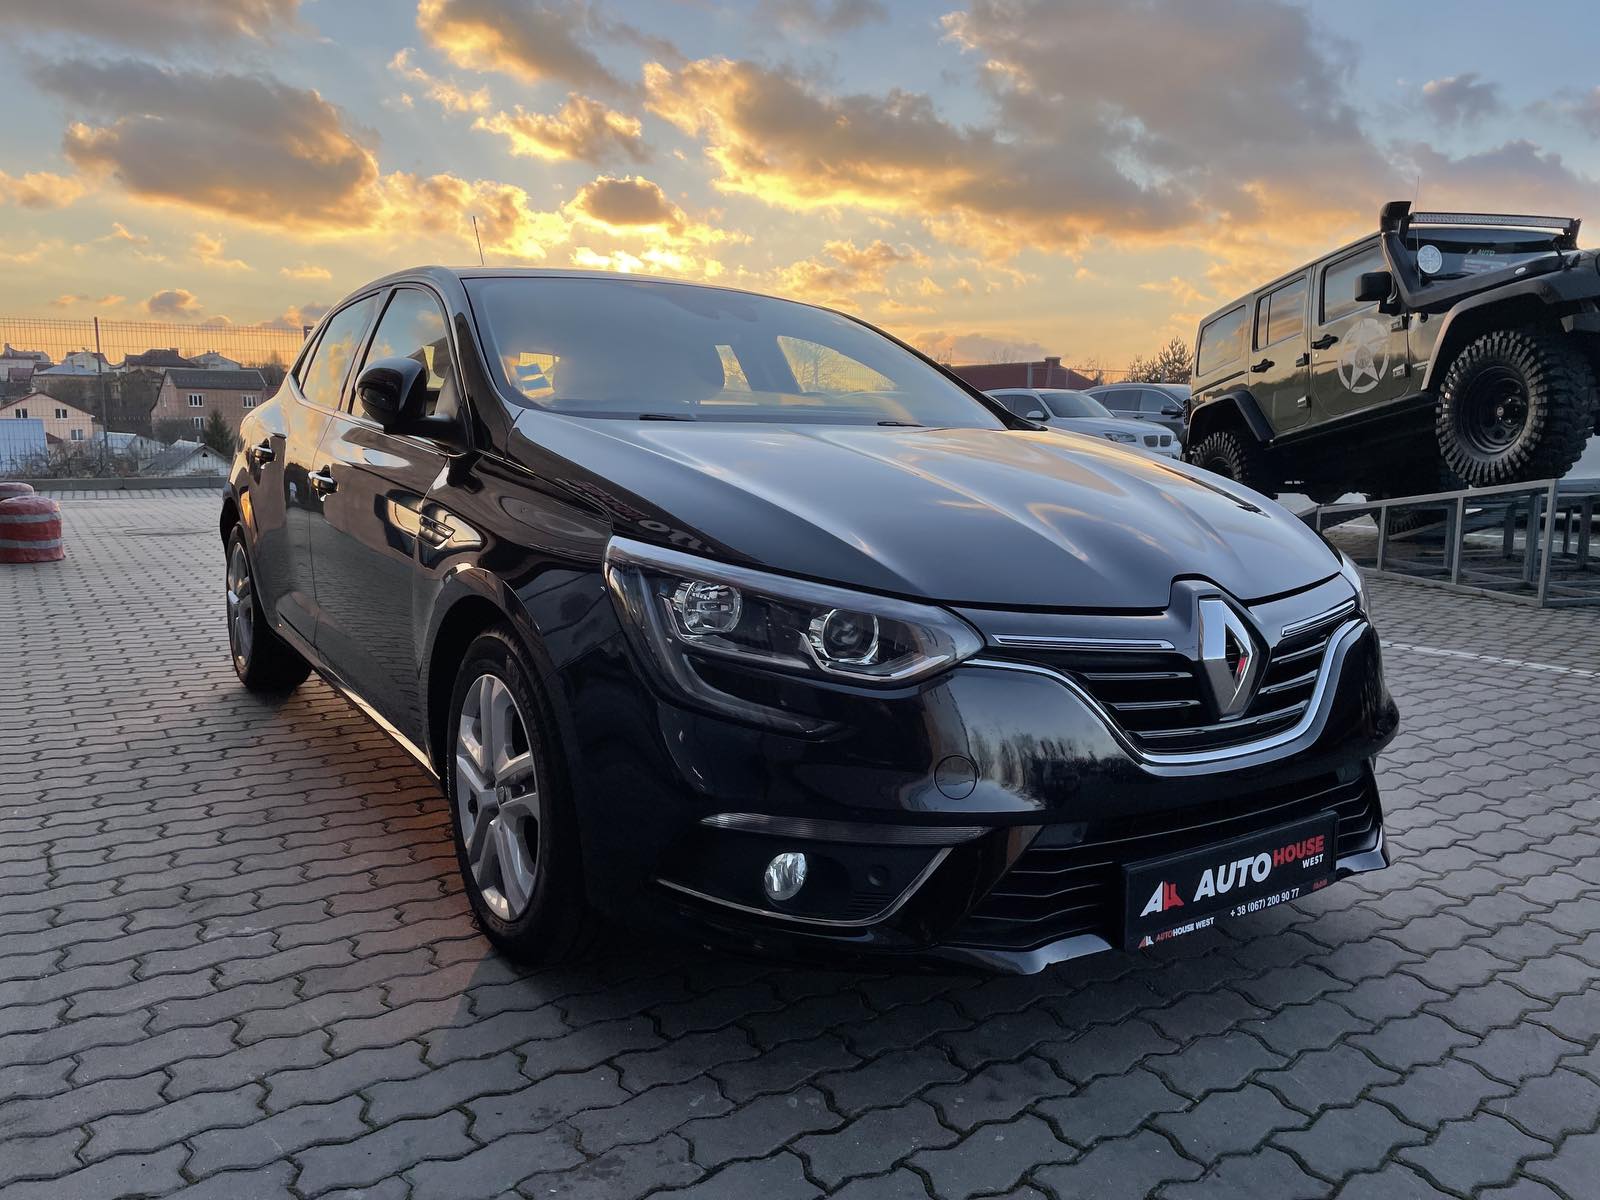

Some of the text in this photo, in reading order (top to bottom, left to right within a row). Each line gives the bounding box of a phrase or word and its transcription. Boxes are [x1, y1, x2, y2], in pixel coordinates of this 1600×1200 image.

[1193, 835, 1325, 902] AUTO HOUSE
[1302, 853, 1324, 869] WEST
[1236, 905, 1246, 917] 38
[1247, 898, 1266, 914] (067)
[1267, 893, 1281, 906] 200
[1281, 891, 1290, 902] 90
[1291, 887, 1300, 899] 77
[1195, 916, 1215, 930] WEST
